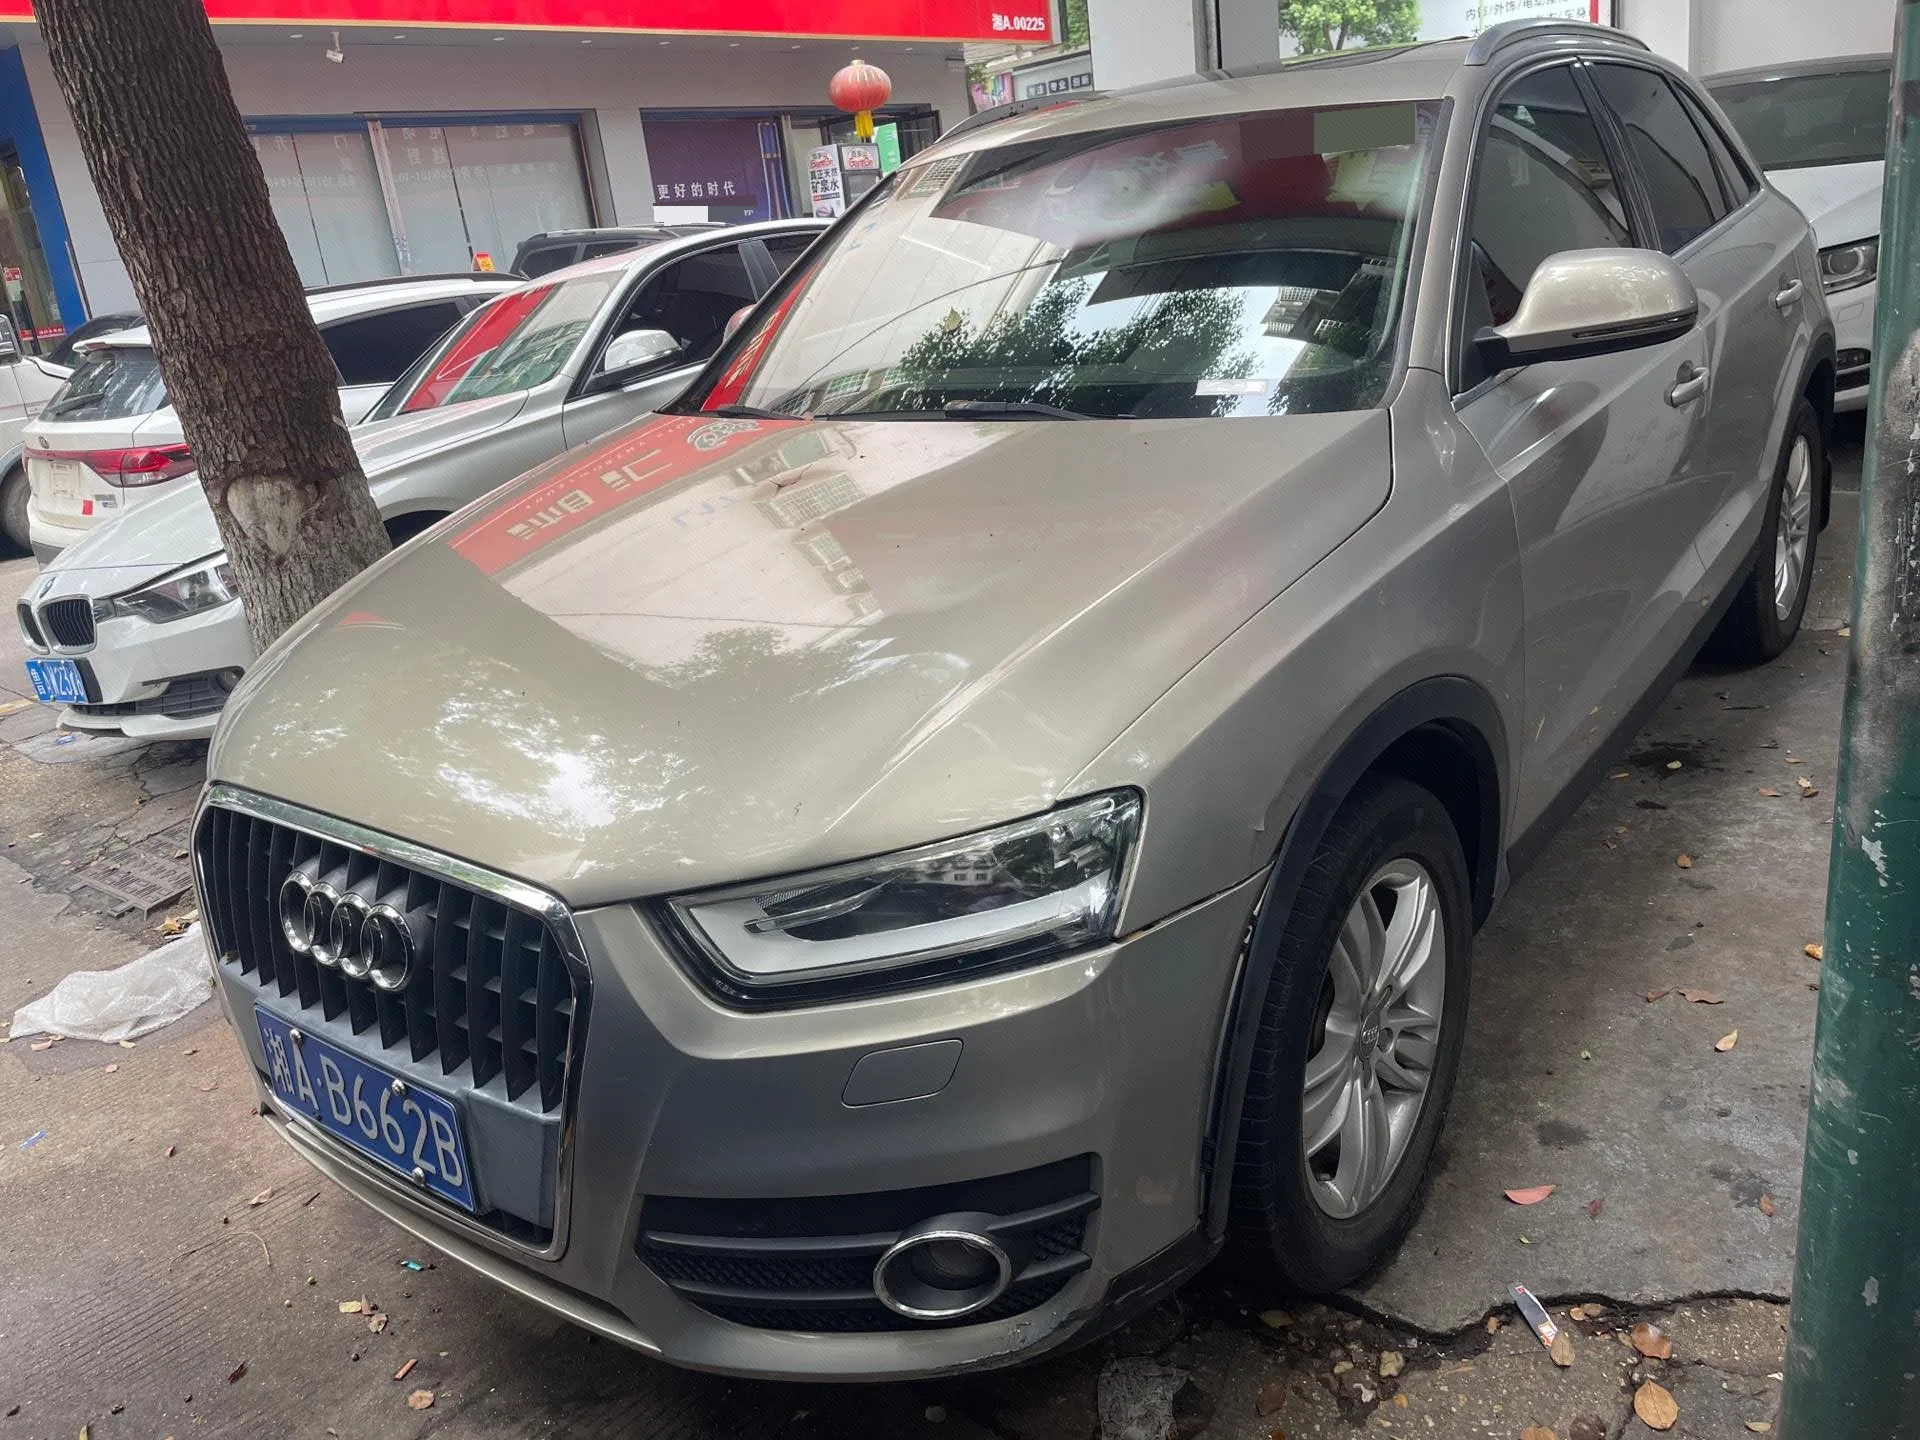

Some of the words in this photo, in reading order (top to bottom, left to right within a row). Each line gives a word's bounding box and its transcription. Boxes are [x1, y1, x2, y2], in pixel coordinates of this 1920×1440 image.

[991, 12, 1046, 31] 湘A.00225
[810, 167, 838, 180] 真正天然
[656, 180, 736, 200] 更好的时代
[810, 178, 840, 193] 矿泉水
